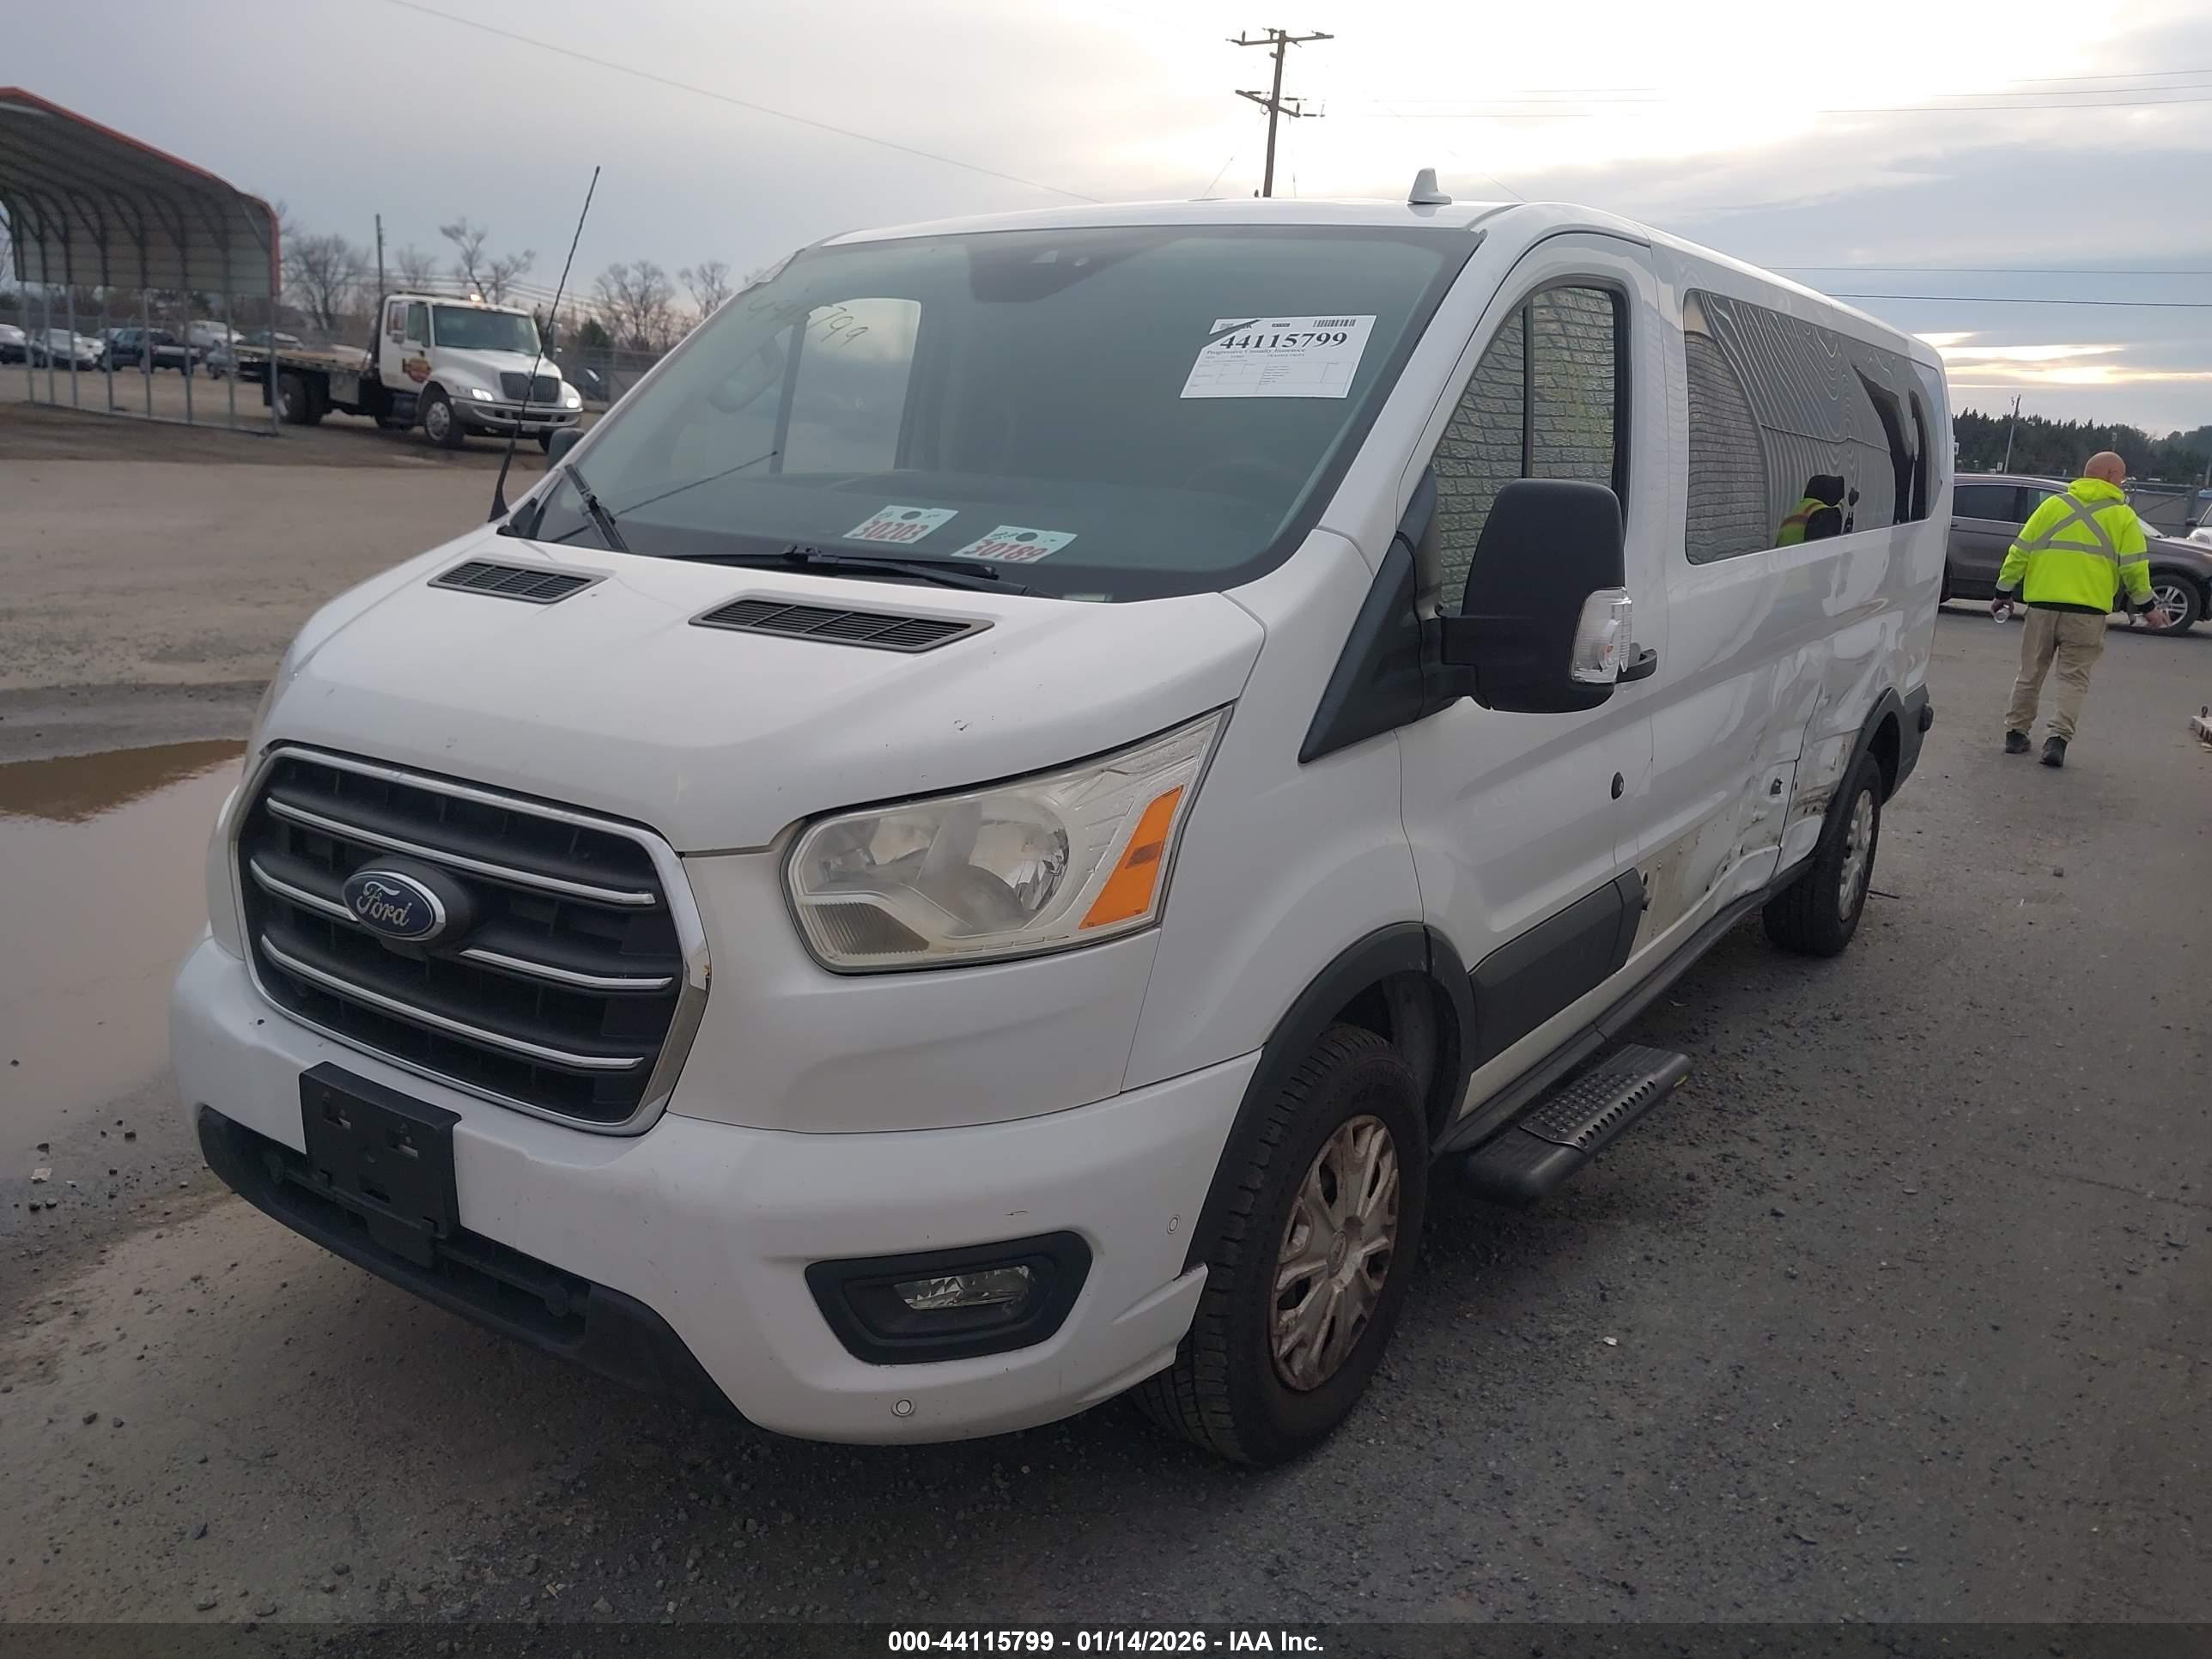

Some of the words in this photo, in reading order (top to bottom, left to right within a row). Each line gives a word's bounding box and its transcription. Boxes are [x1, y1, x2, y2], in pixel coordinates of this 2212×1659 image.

[1219, 332, 1348, 349] 44115799
[851, 520, 929, 541] 30203
[963, 539, 1048, 562] 30189
[356, 881, 413, 927] Ford
